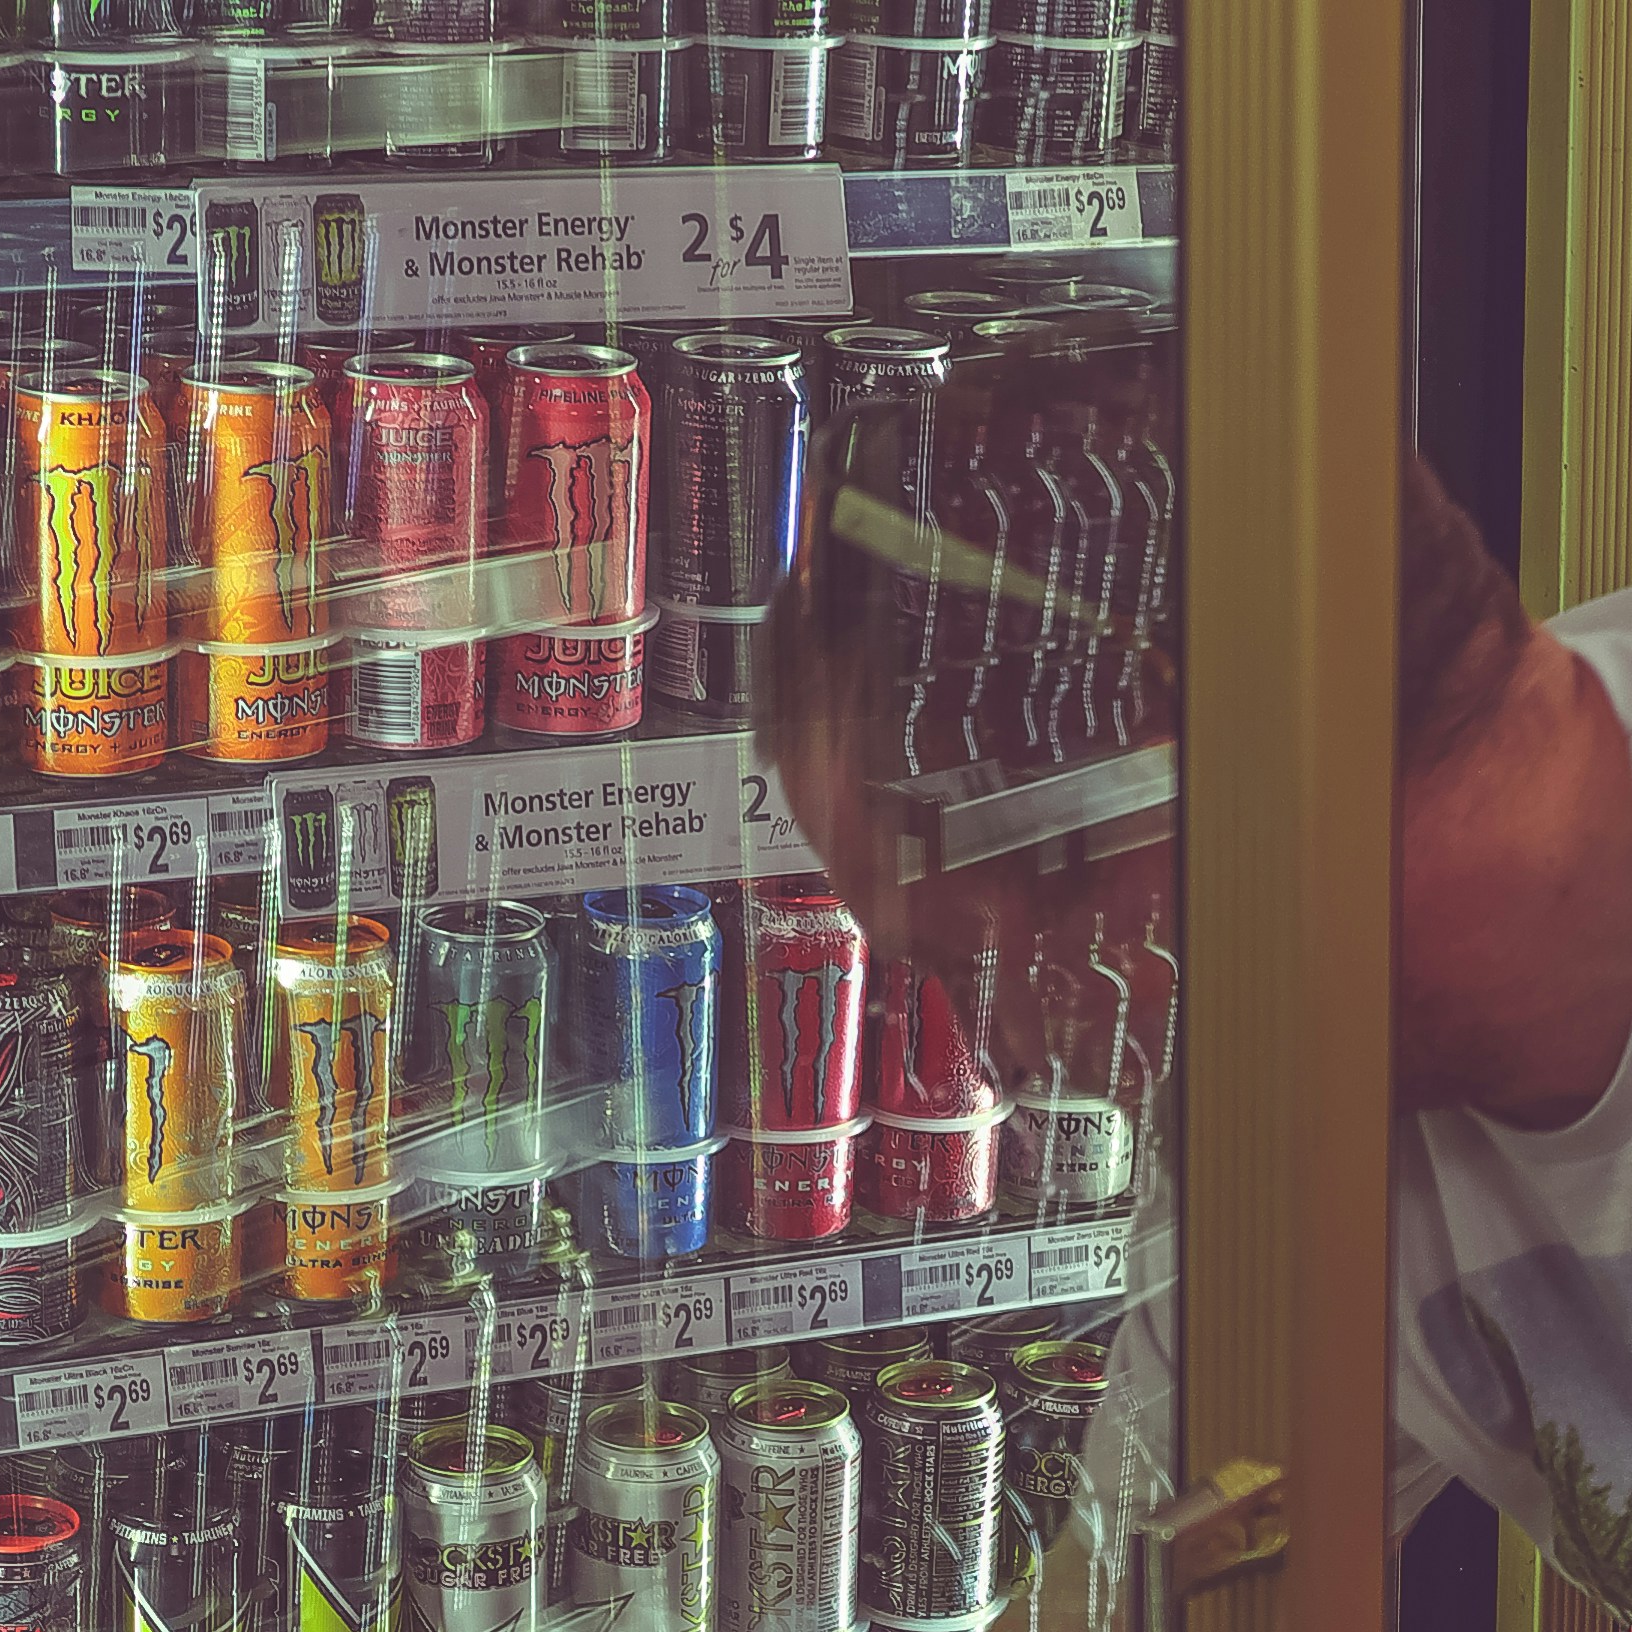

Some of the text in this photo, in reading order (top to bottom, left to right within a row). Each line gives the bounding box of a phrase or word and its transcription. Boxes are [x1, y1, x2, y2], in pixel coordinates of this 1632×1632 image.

[415, 212, 630, 242] Monster Energy
[404, 246, 642, 278] & Monster Rehab
[681, 212, 712, 263] 2
[710, 258, 741, 286] for
[483, 778, 695, 818] Monster Energy
[742, 774, 771, 824] 2
[475, 808, 704, 853] & Monster Rehab
